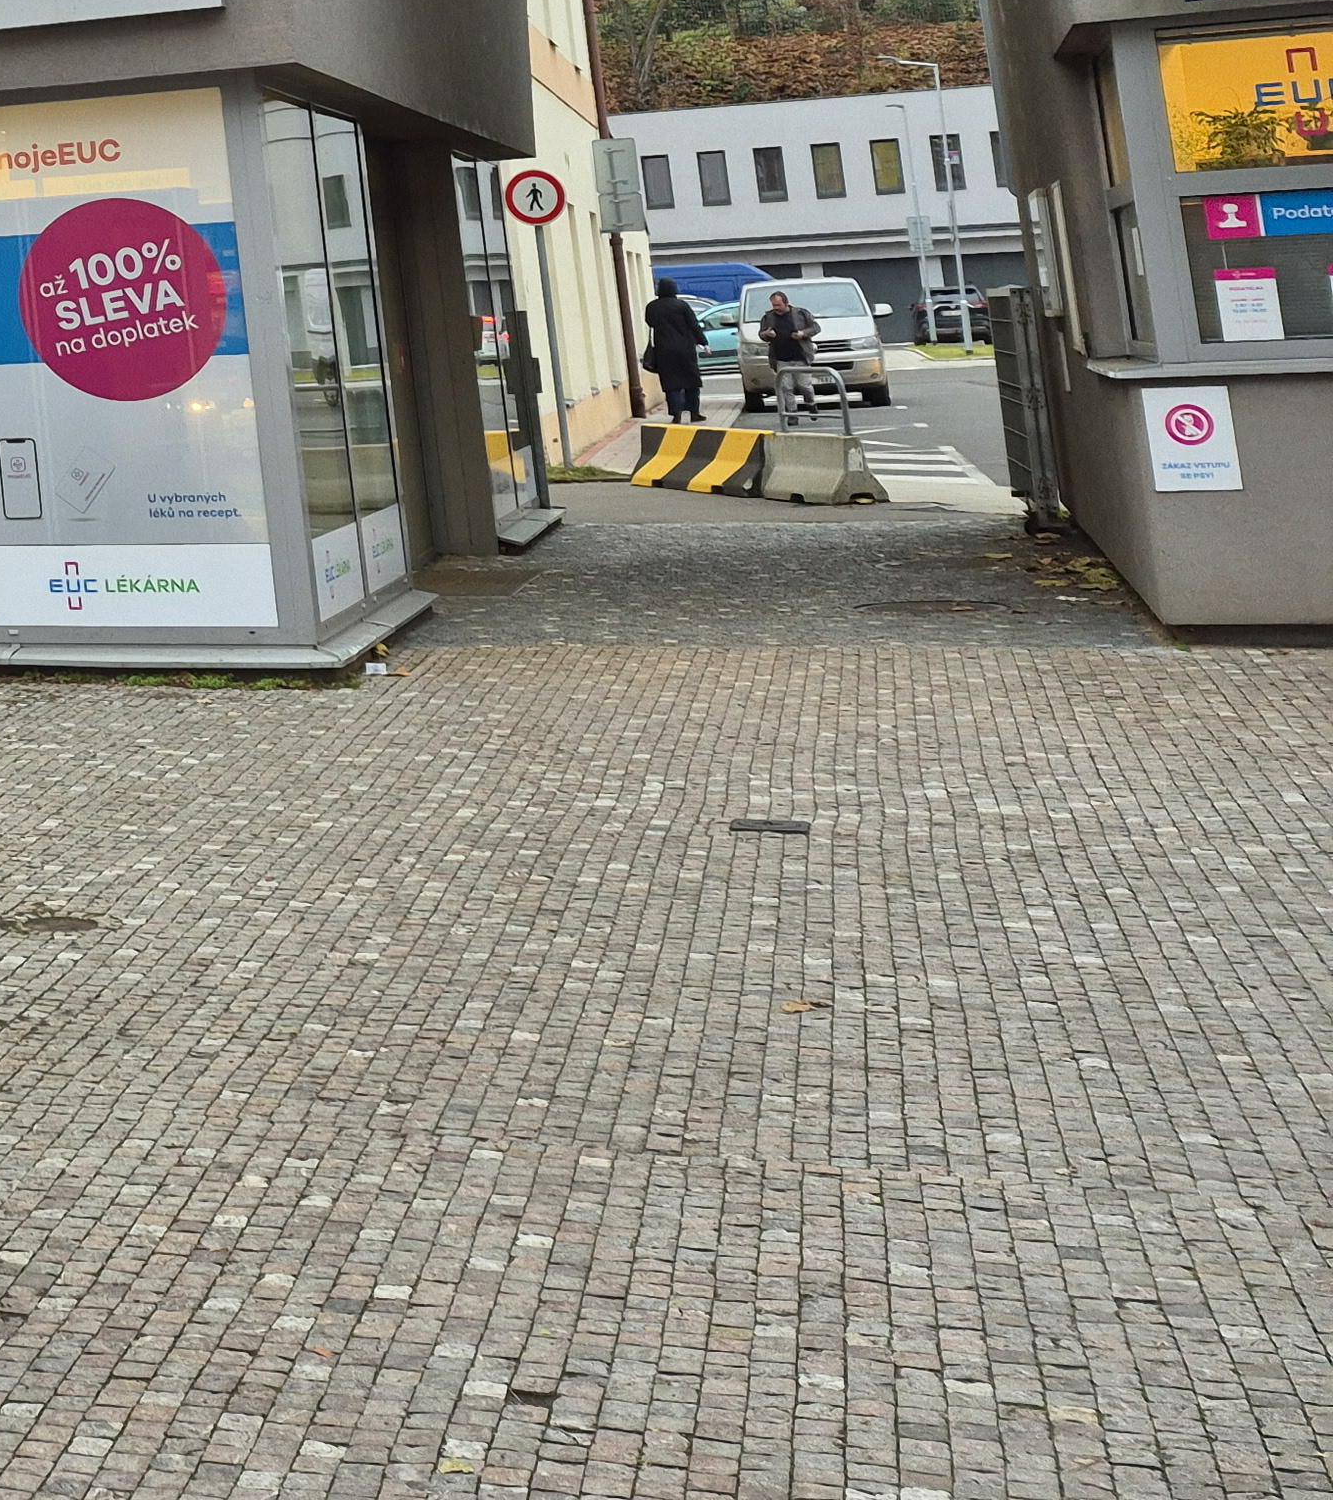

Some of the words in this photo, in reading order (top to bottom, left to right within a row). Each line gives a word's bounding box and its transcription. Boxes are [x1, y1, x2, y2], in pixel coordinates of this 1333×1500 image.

[1255, 79, 1333, 106] EU
[39, 274, 69, 297] až
[69, 239, 182, 290] 100%
[55, 280, 185, 330] SLEVA
[55, 337, 86, 357] na
[91, 311, 200, 348] doplatek
[147, 493, 157, 504] U
[159, 492, 227, 506] vybraných
[149, 506, 175, 518] léků
[177, 509, 194, 518] na
[49, 579, 99, 593] EUC
[105, 575, 201, 593] LÉKÁRNA
